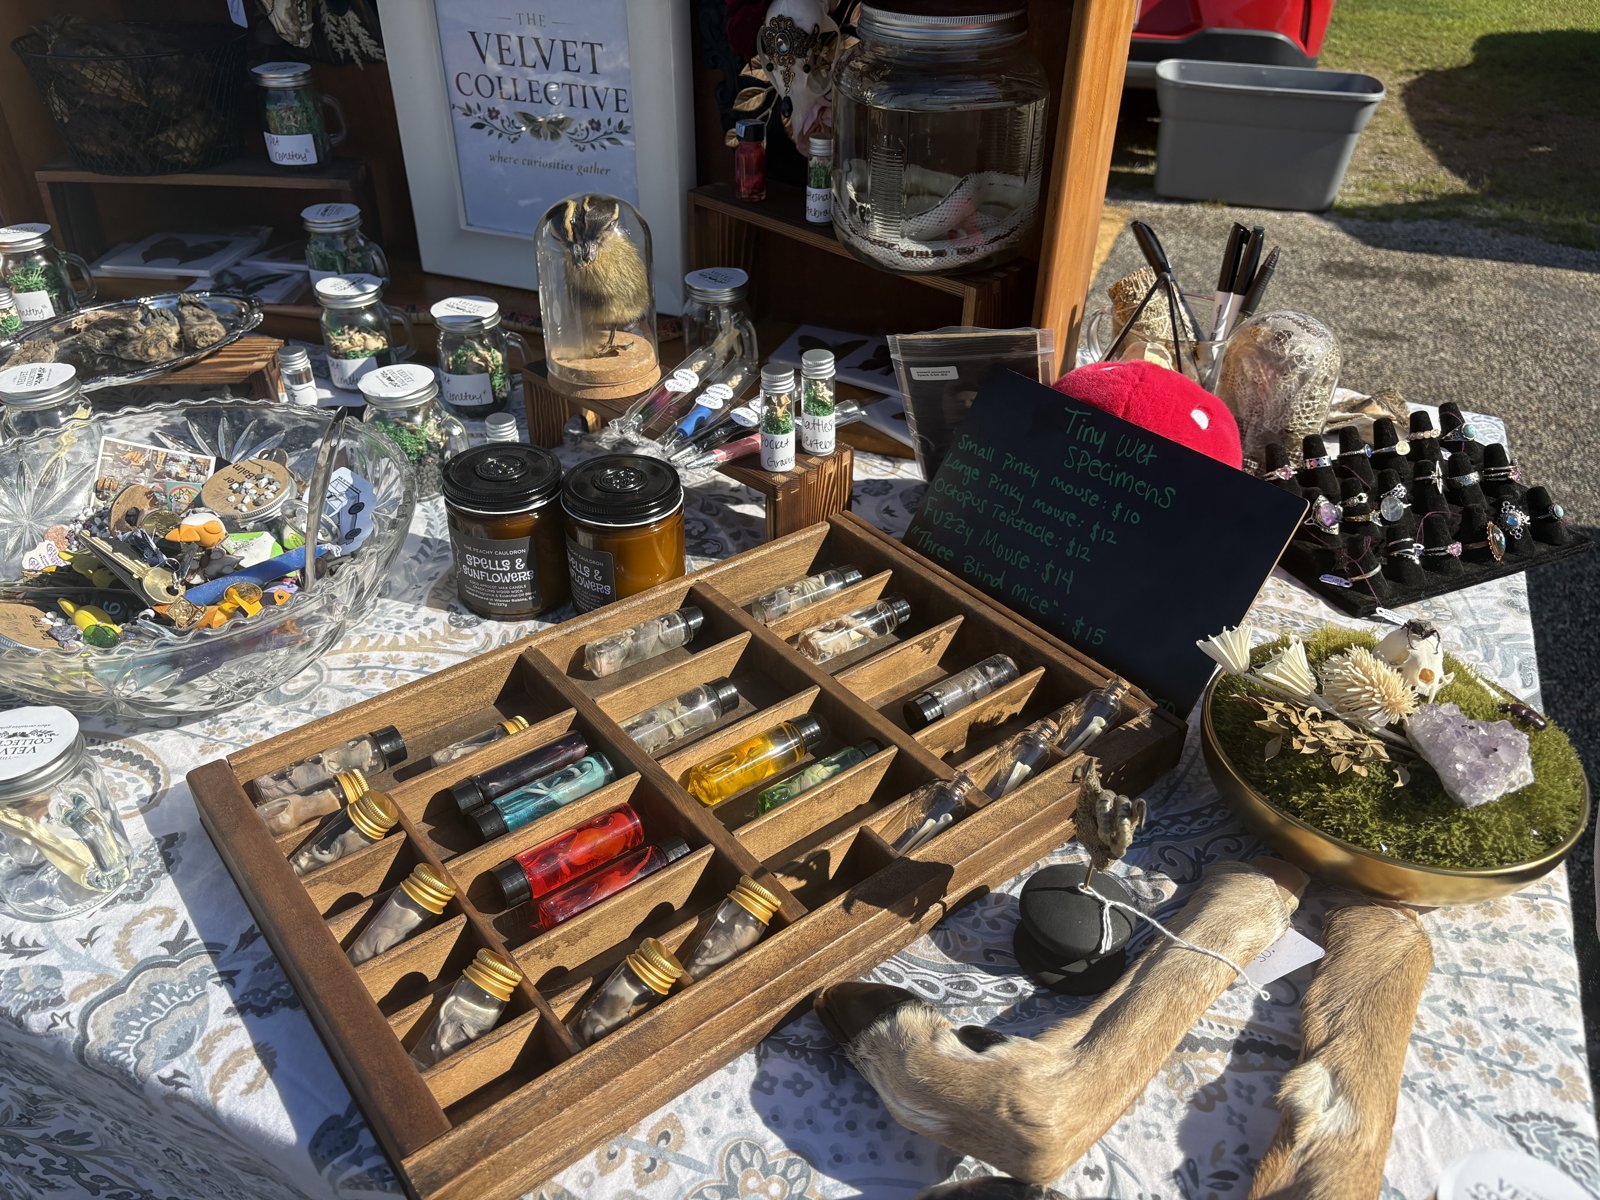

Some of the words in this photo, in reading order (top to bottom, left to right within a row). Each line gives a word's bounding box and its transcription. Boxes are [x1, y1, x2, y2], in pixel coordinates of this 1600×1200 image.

[515, 12, 546, 28] THE
[467, 30, 604, 75] VELVET
[455, 71, 630, 114] COLLECTIVE
[488, 152, 519, 166] where
[521, 157, 574, 172] curiosities
[576, 160, 612, 177] gather
[1064, 407, 1107, 455] Tiny
[1115, 433, 1158, 466] Wet
[958, 433, 996, 463] Small
[1111, 502, 1141, 524] $10
[943, 452, 980, 487] Large
[1089, 520, 1118, 545] $12
[473, 547, 494, 555] PEACHY
[494, 548, 526, 556] CAULDRON
[515, 557, 526, 570] &
[1065, 537, 1092, 563] $12
[593, 569, 603, 581] &
[1040, 560, 1075, 596] $14
[963, 555, 1006, 591] Blind
[1071, 616, 1107, 646] $15
[0, 746, 36, 755] VELV
